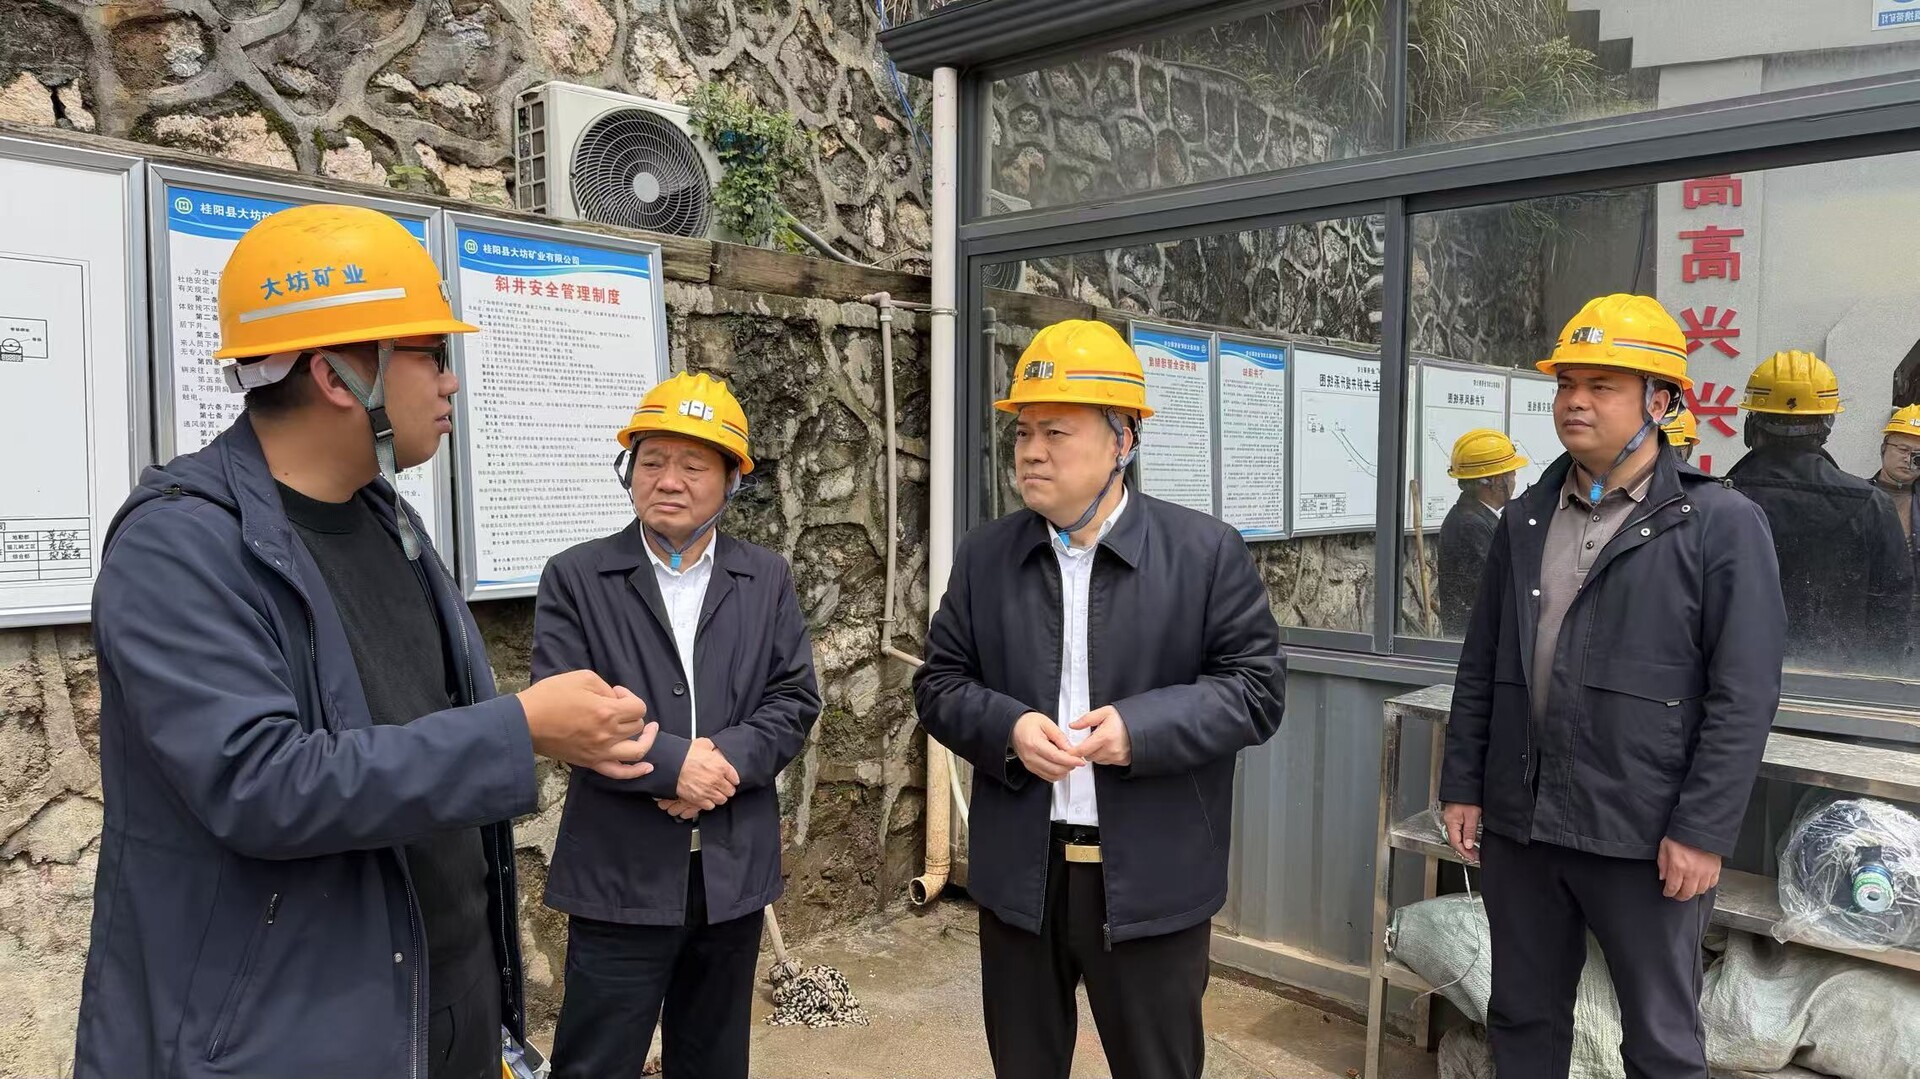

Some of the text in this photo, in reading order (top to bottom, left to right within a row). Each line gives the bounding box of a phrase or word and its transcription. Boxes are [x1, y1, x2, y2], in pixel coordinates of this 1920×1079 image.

[483, 244, 580, 266] 桂阳县大坊矿业有限公司
[260, 264, 367, 300] 大坊矿业
[495, 275, 621, 305] 斜井安全管理制度
